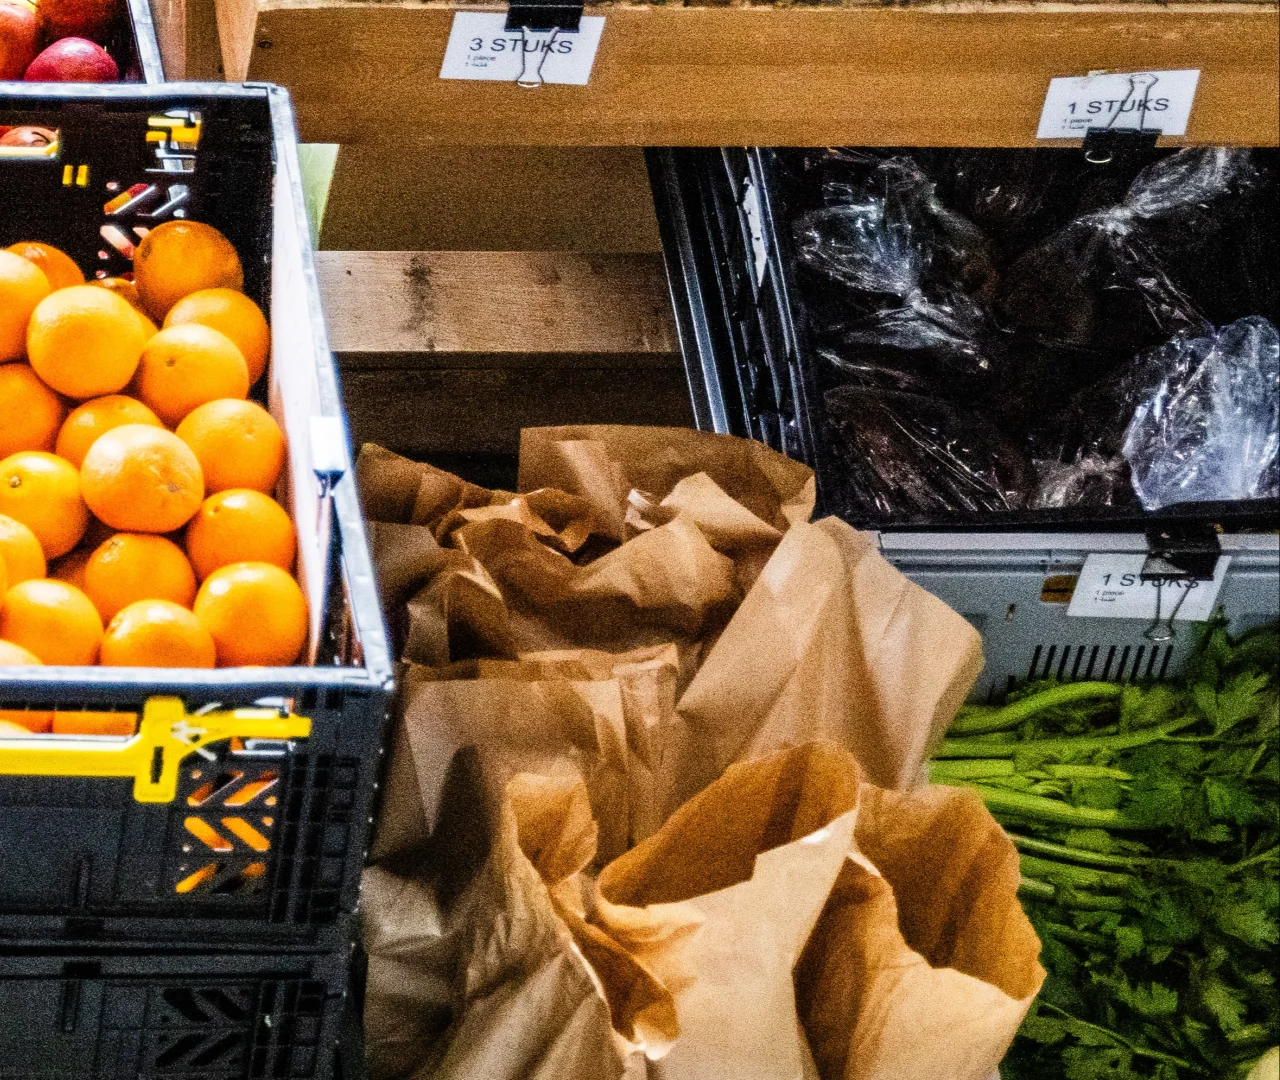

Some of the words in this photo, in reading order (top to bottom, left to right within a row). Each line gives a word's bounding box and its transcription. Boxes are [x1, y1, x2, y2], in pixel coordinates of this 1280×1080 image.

[469, 37, 483, 52] 3
[490, 38, 573, 54] STUKS
[1068, 102, 1076, 115] 1
[1086, 98, 1170, 114] STUKS
[1103, 574, 1112, 586] 1
